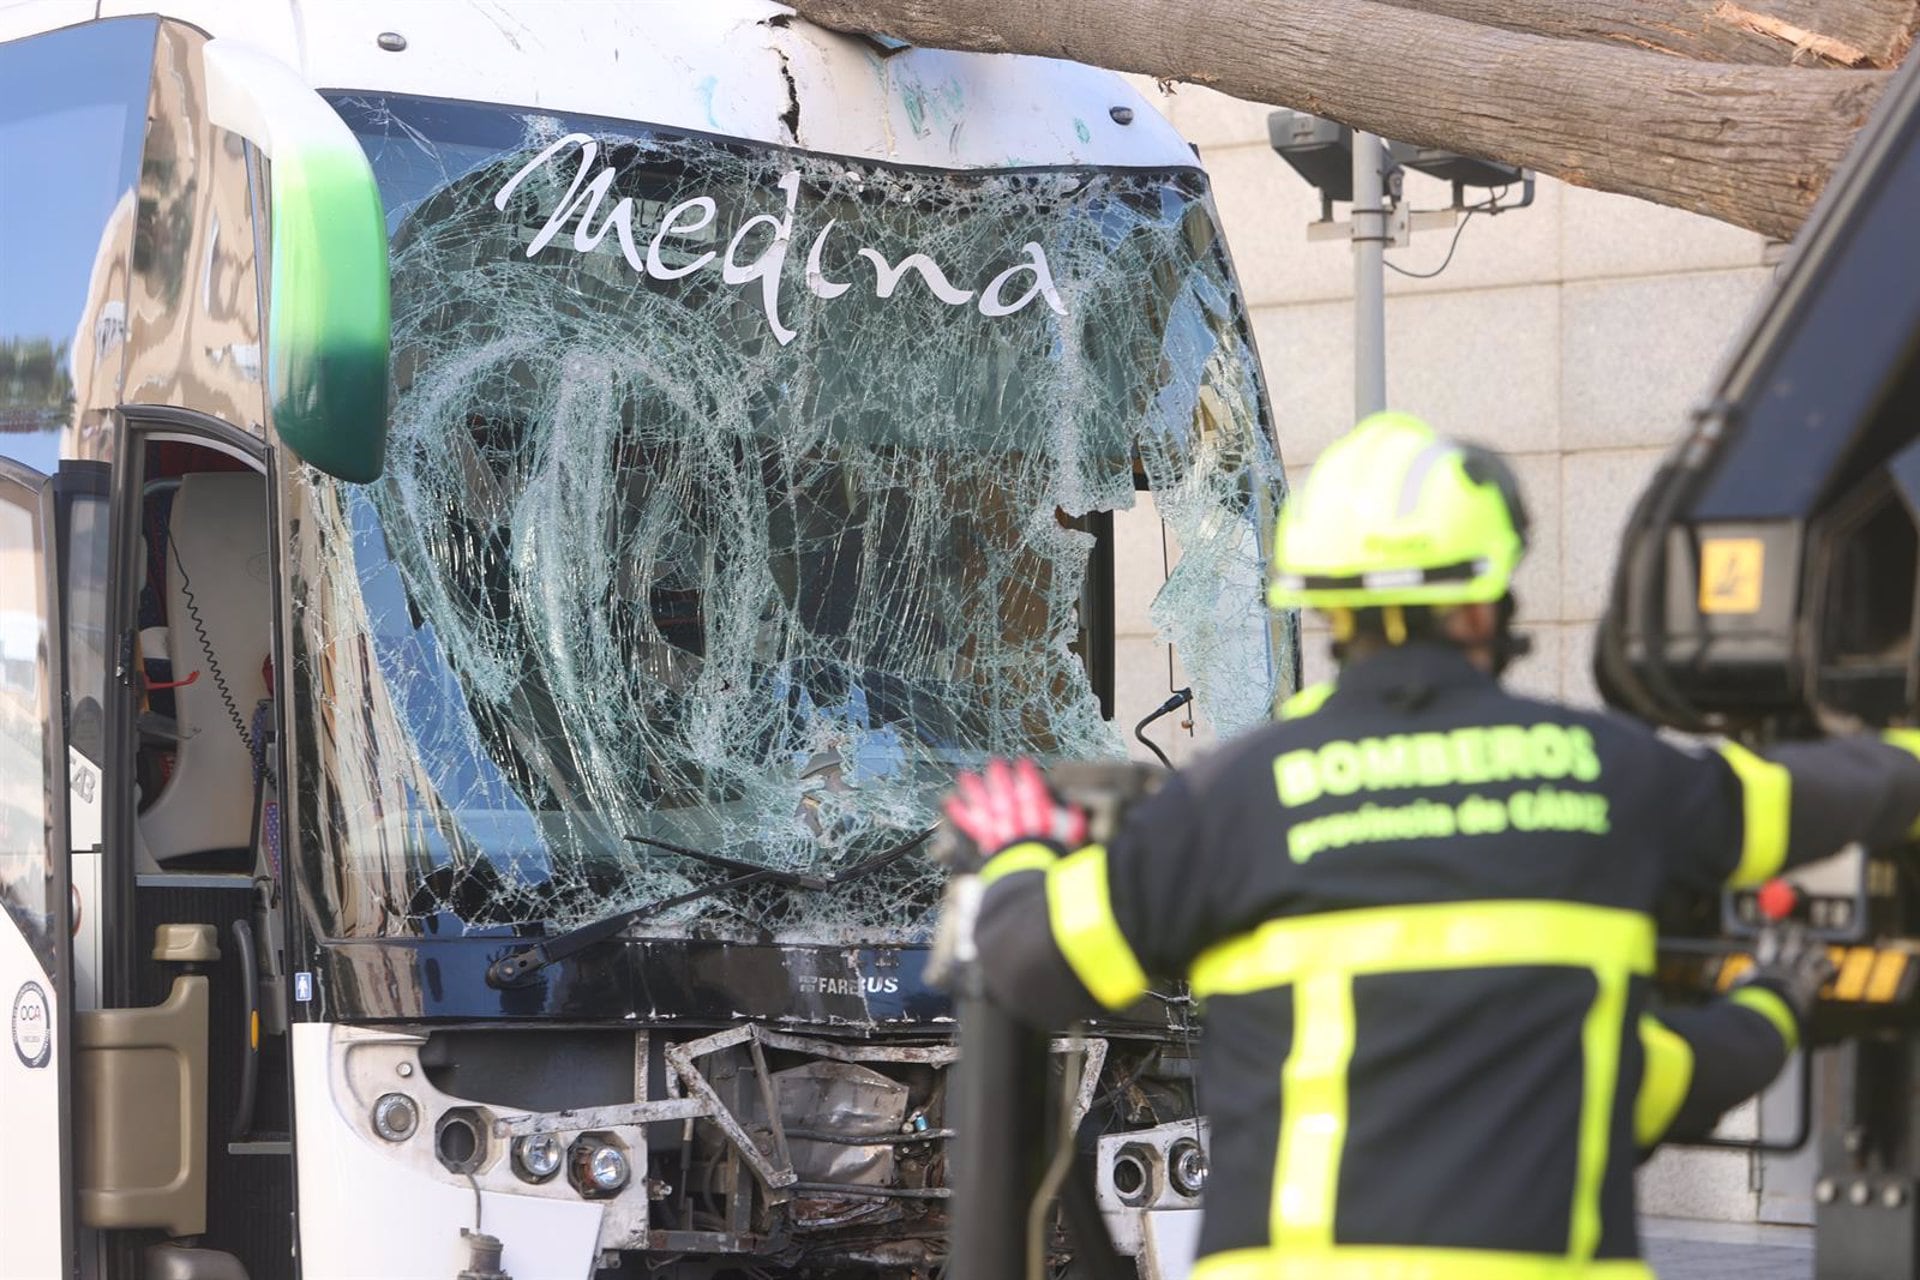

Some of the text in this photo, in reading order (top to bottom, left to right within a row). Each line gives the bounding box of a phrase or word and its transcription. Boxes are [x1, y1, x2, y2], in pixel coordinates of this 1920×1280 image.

[494, 132, 1069, 346] Medina
[1274, 722, 1601, 807] BOMBEROS
[21, 1005, 41, 1021] OCA
